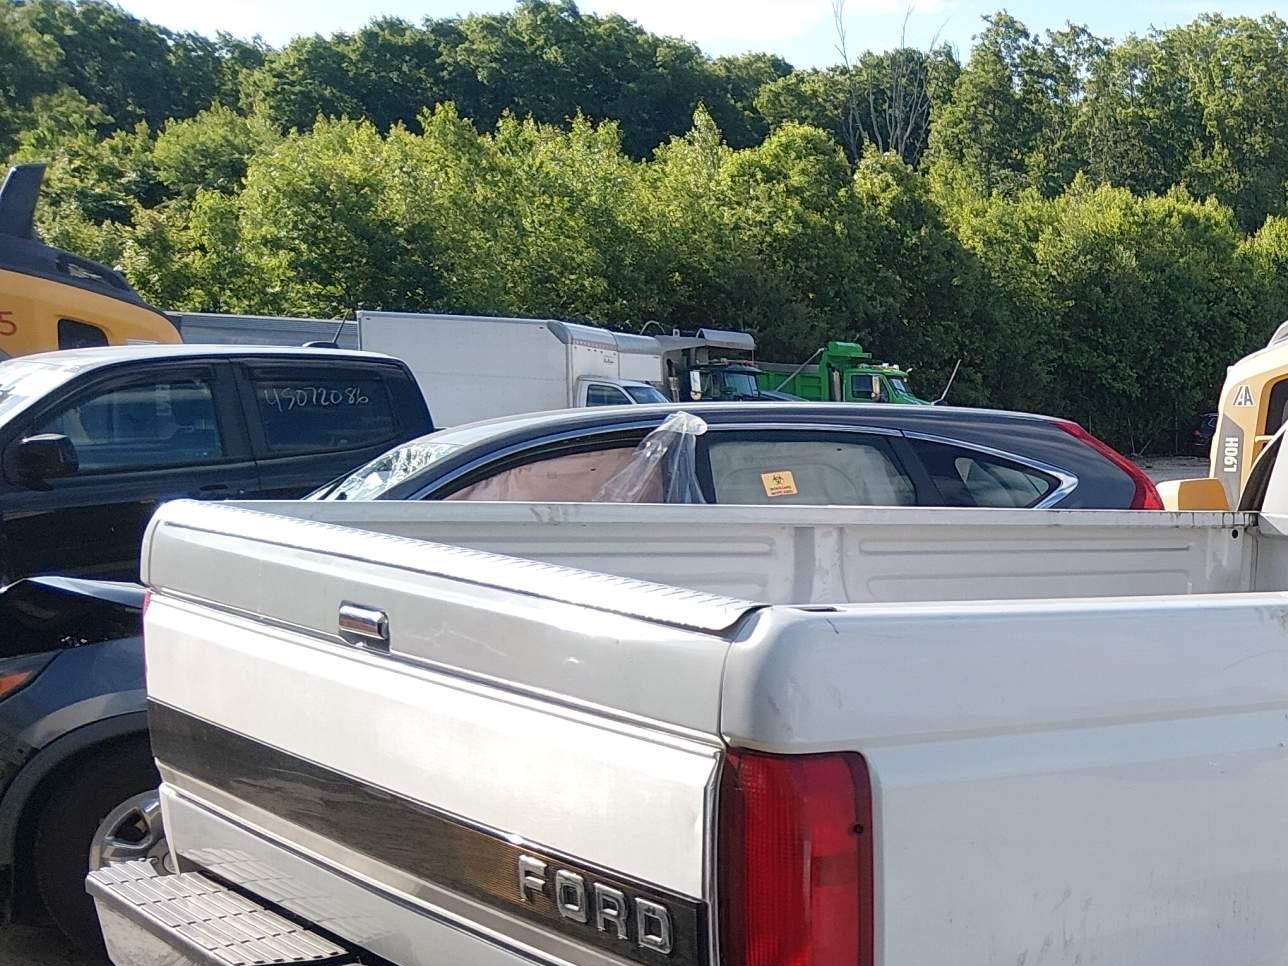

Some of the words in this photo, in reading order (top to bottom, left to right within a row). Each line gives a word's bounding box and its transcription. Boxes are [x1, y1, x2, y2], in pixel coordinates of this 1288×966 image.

[263, 385, 369, 412] 45072086
[1223, 437, 1239, 473] L90H
[518, 854, 674, 955] FORD
